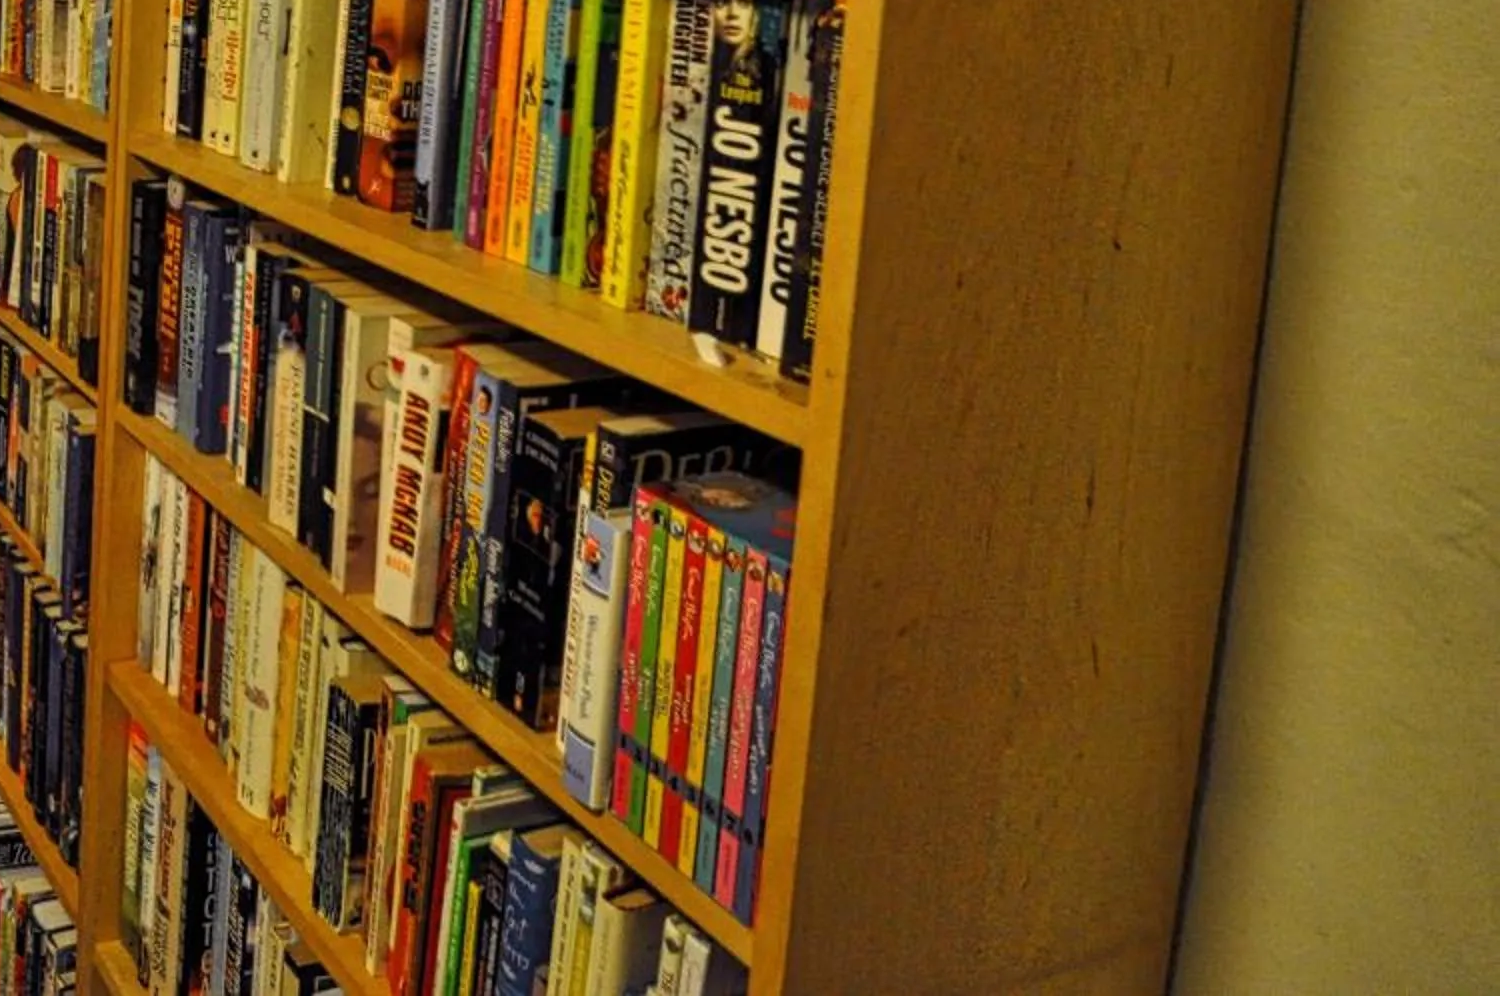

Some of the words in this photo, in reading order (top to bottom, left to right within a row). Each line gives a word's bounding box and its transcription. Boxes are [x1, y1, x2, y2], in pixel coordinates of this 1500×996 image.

[691, 2, 711, 65] KARIN
[720, 84, 763, 107] Leopard
[713, 106, 762, 162] JO
[134, 197, 143, 219] THE
[663, 122, 700, 282] fractured
[700, 166, 758, 294] NESBO
[243, 271, 254, 303] FAT
[286, 364, 305, 439] JOANNE
[402, 392, 431, 463] ANDY
[472, 420, 492, 483] PETER
[285, 448, 301, 517] HARRIS
[389, 464, 422, 558] McNAB
[685, 567, 699, 599] Enid
[682, 601, 696, 641] Blyton
[762, 611, 779, 647] Enid
[760, 648, 774, 689] Blyton
